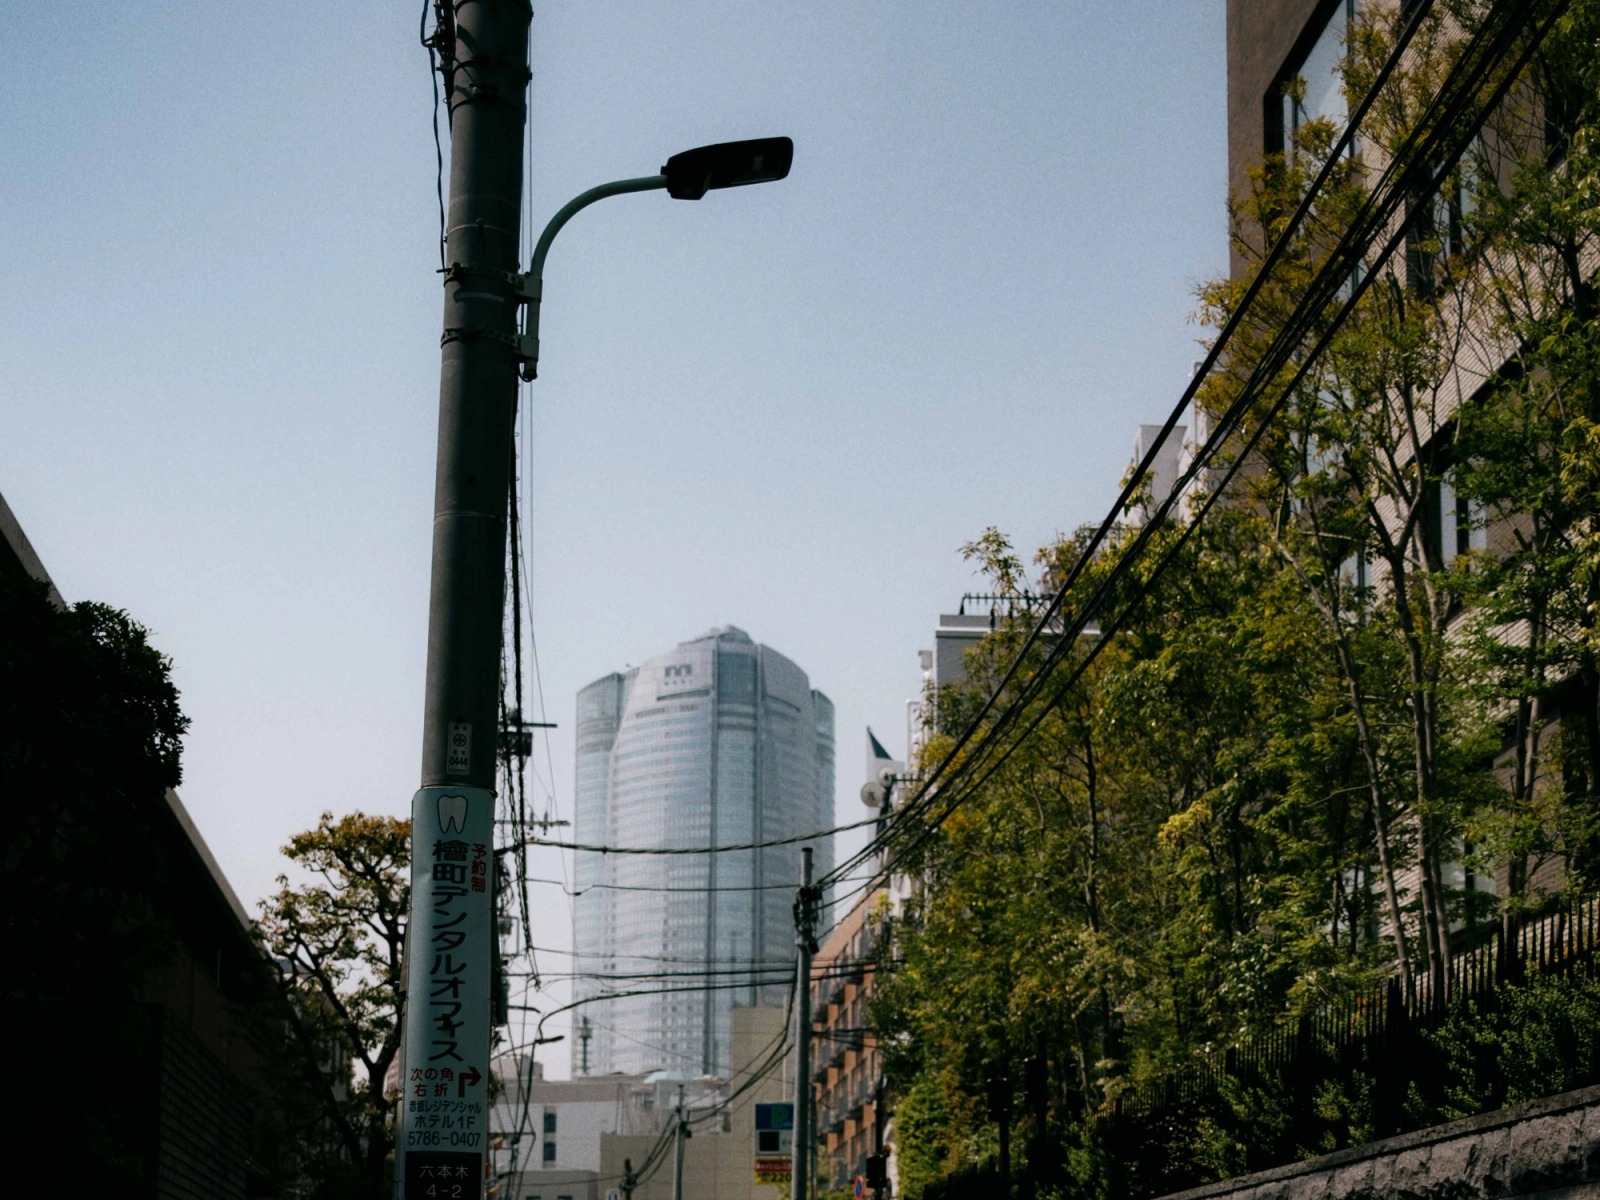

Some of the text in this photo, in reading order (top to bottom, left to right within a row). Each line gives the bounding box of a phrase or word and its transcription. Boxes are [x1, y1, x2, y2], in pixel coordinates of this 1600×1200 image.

[470, 843, 487, 893] 予約制
[428, 839, 470, 1062] 檜町デンタルオフィス
[410, 1067, 454, 1081] 次の角
[414, 1083, 448, 1097] 右折
[408, 1100, 482, 1114] 赤坂レジデンシャル
[407, 1130, 481, 1147] 5786-0407
[419, 1164, 469, 1179] 六本木
[426, 1184, 462, 1199] 4-2
